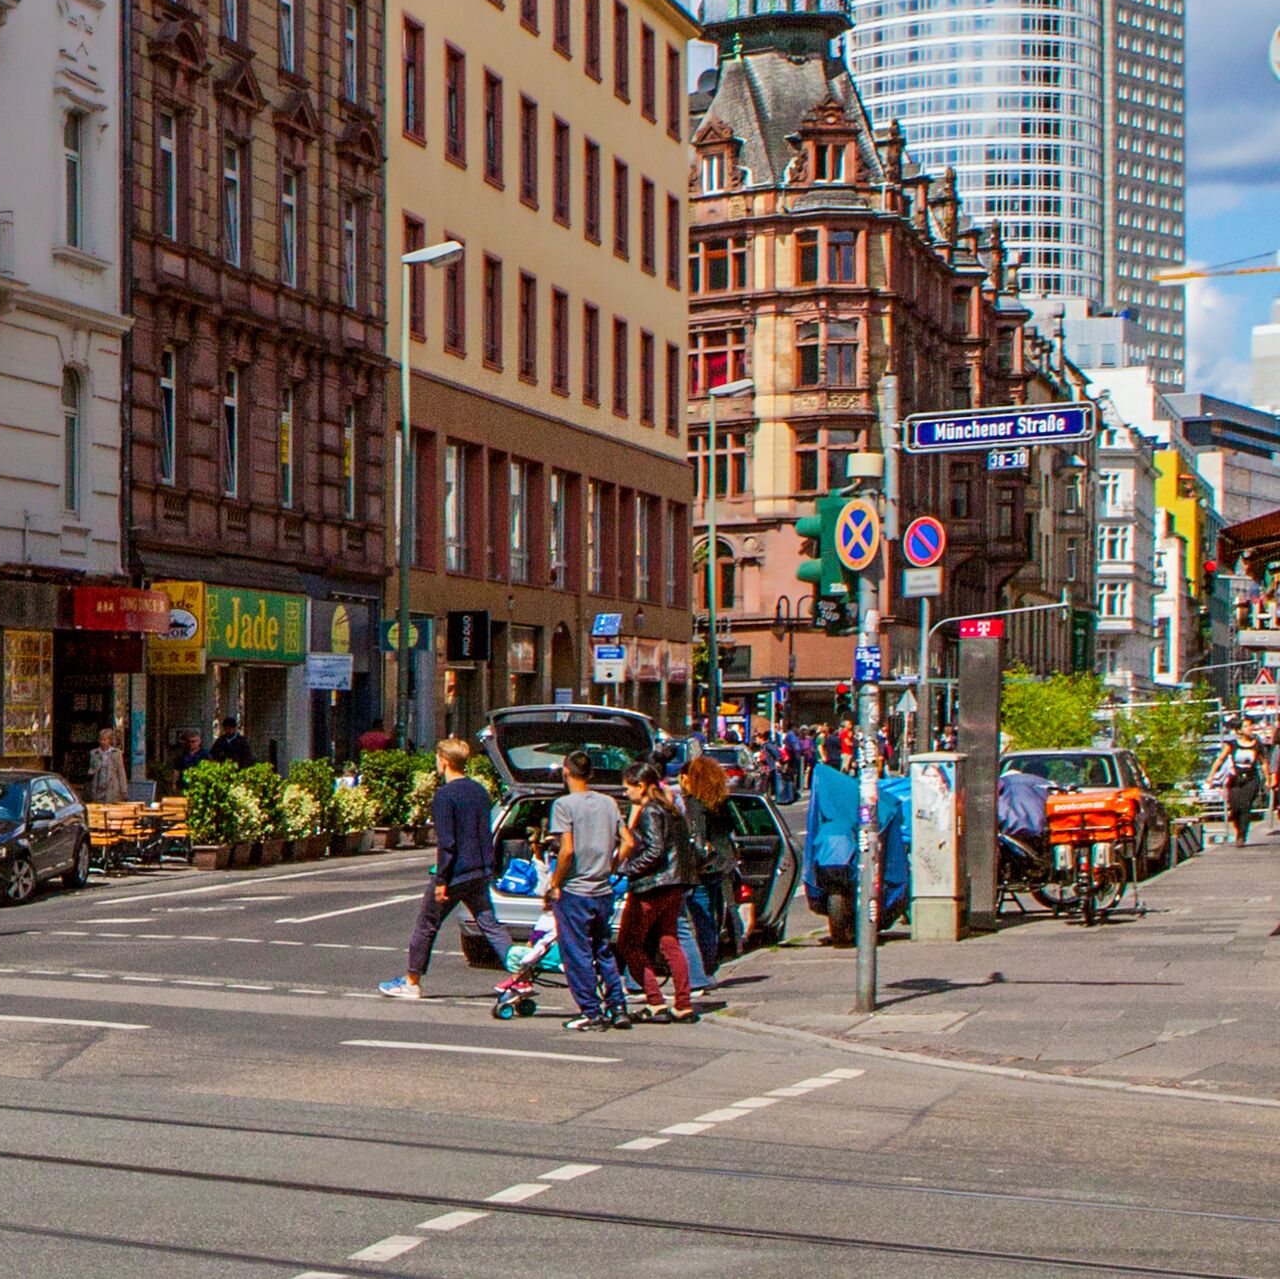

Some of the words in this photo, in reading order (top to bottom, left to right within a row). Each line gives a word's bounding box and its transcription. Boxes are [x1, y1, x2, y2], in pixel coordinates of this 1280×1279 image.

[934, 422, 1013, 441] Münchener
[1017, 414, 1066, 435] Straße
[990, 452, 1027, 468] 38-30
[226, 596, 279, 650] Jade
[1054, 801, 1093, 813] postcon
